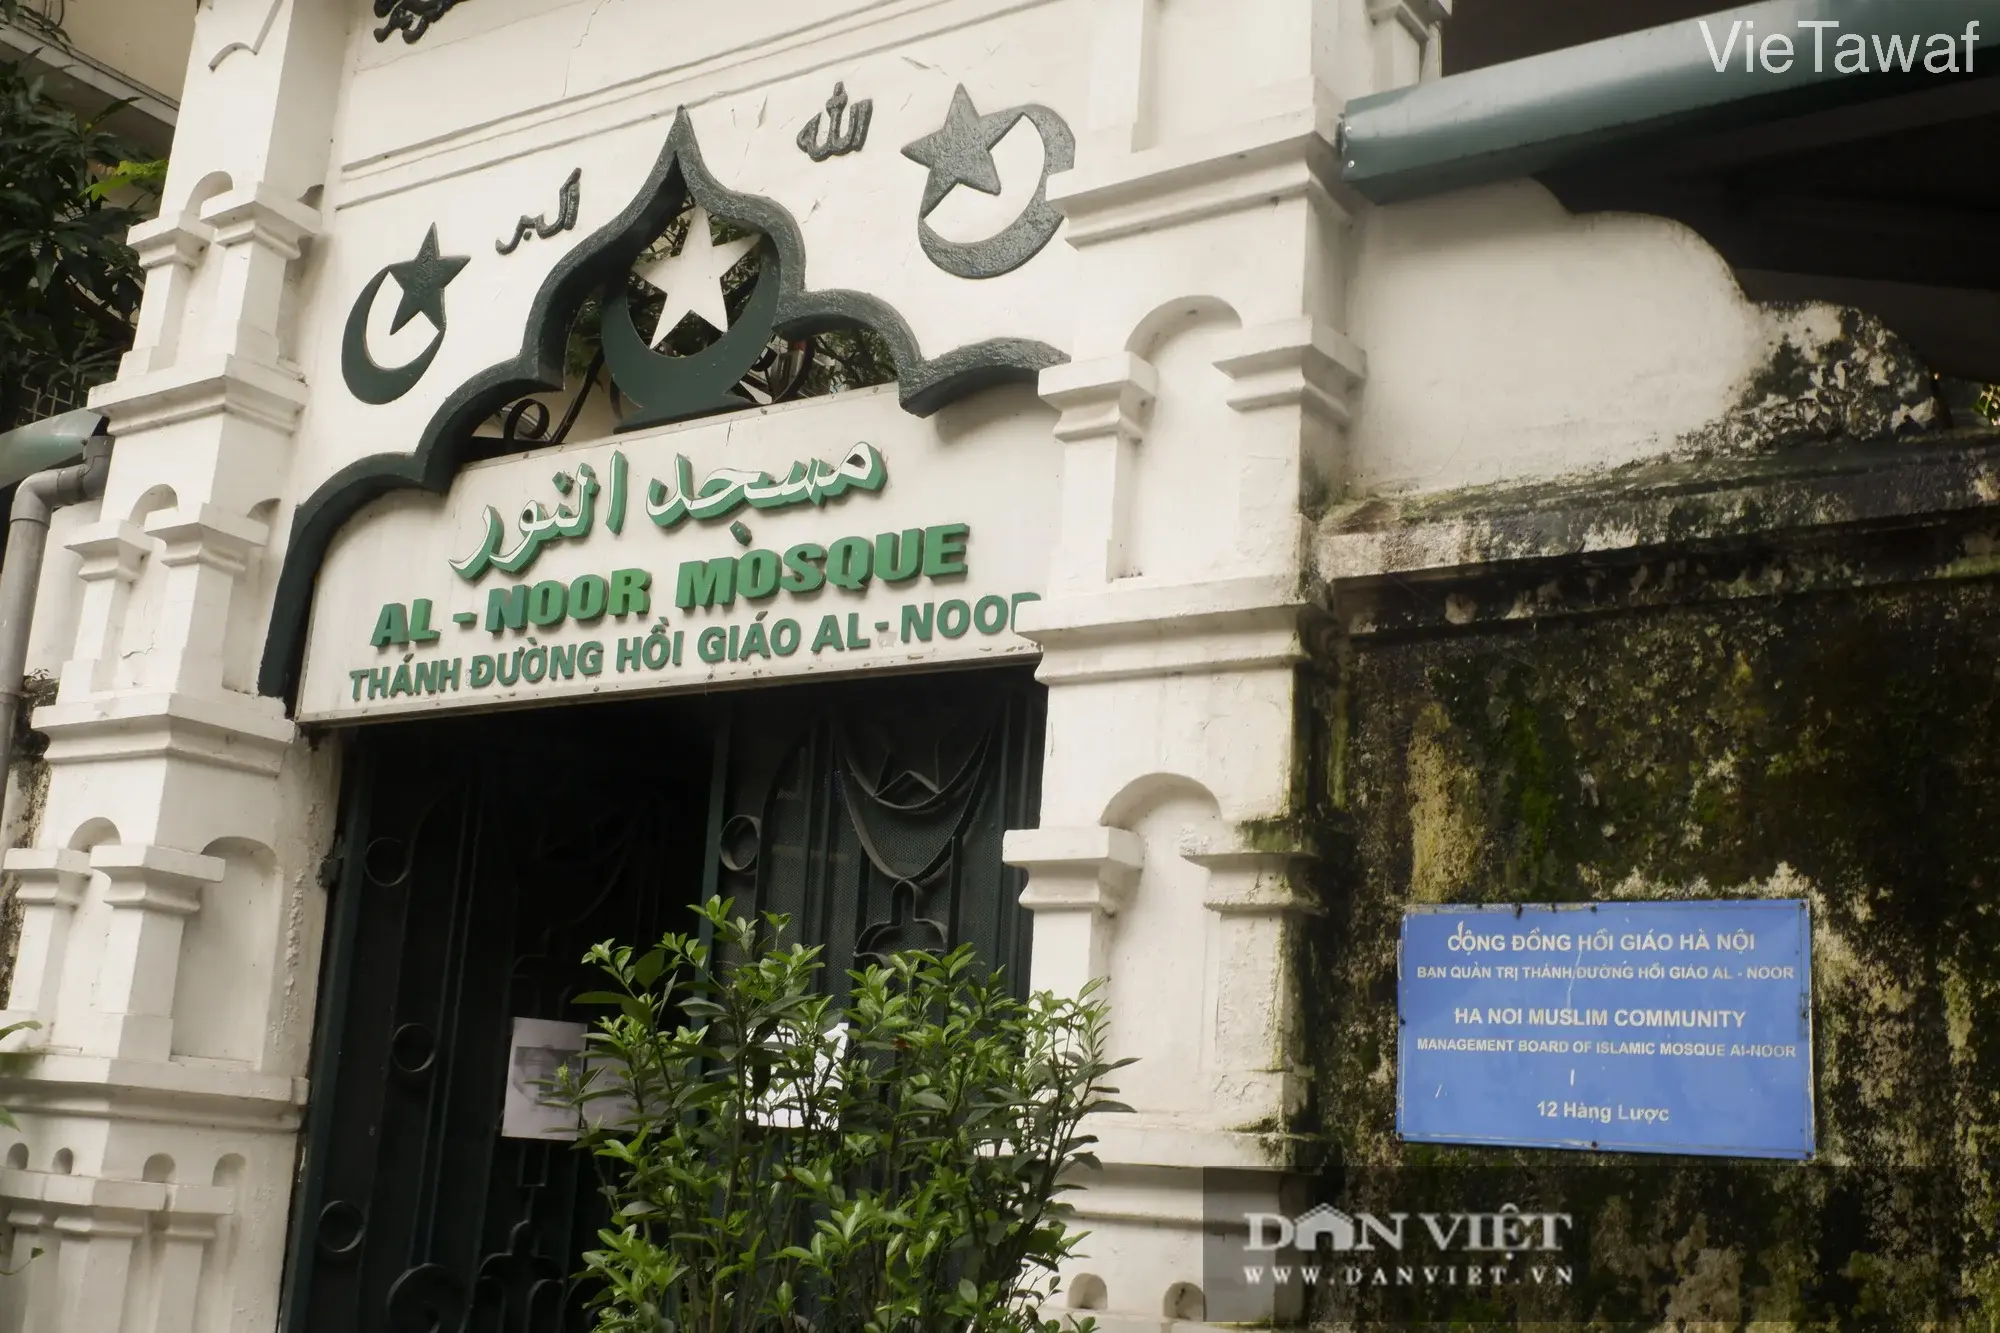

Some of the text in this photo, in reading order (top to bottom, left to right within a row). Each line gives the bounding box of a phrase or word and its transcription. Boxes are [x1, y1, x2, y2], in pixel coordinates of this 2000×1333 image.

[675, 522, 970, 610] MOSQUE
[350, 653, 463, 701] THÁNH
[470, 637, 604, 688] ĐƯỜNG
[616, 616, 684, 672] HỒI
[697, 610, 801, 663] GIÁO
[1511, 927, 1571, 951] ĐỒNG
[1620, 928, 1673, 951] GIÁO
[1680, 928, 1710, 951] HÀ
[1717, 928, 1755, 955] NỘI
[1417, 966, 1447, 979] BAN
[1746, 966, 1794, 979] NOOR
[1454, 1007, 1746, 1028] HA NOI MUSLIM COMMUNITY
[1417, 1038, 1514, 1052] MANAGEMENT
[1518, 1040, 1569, 1053] BOARD
[1573, 1040, 1592, 1053] OF
[1596, 1041, 1655, 1055] ISLAMIC
[1660, 1042, 1726, 1057] MOSQUE
[1537, 1101, 1670, 1125] 12 Hàng Lược
